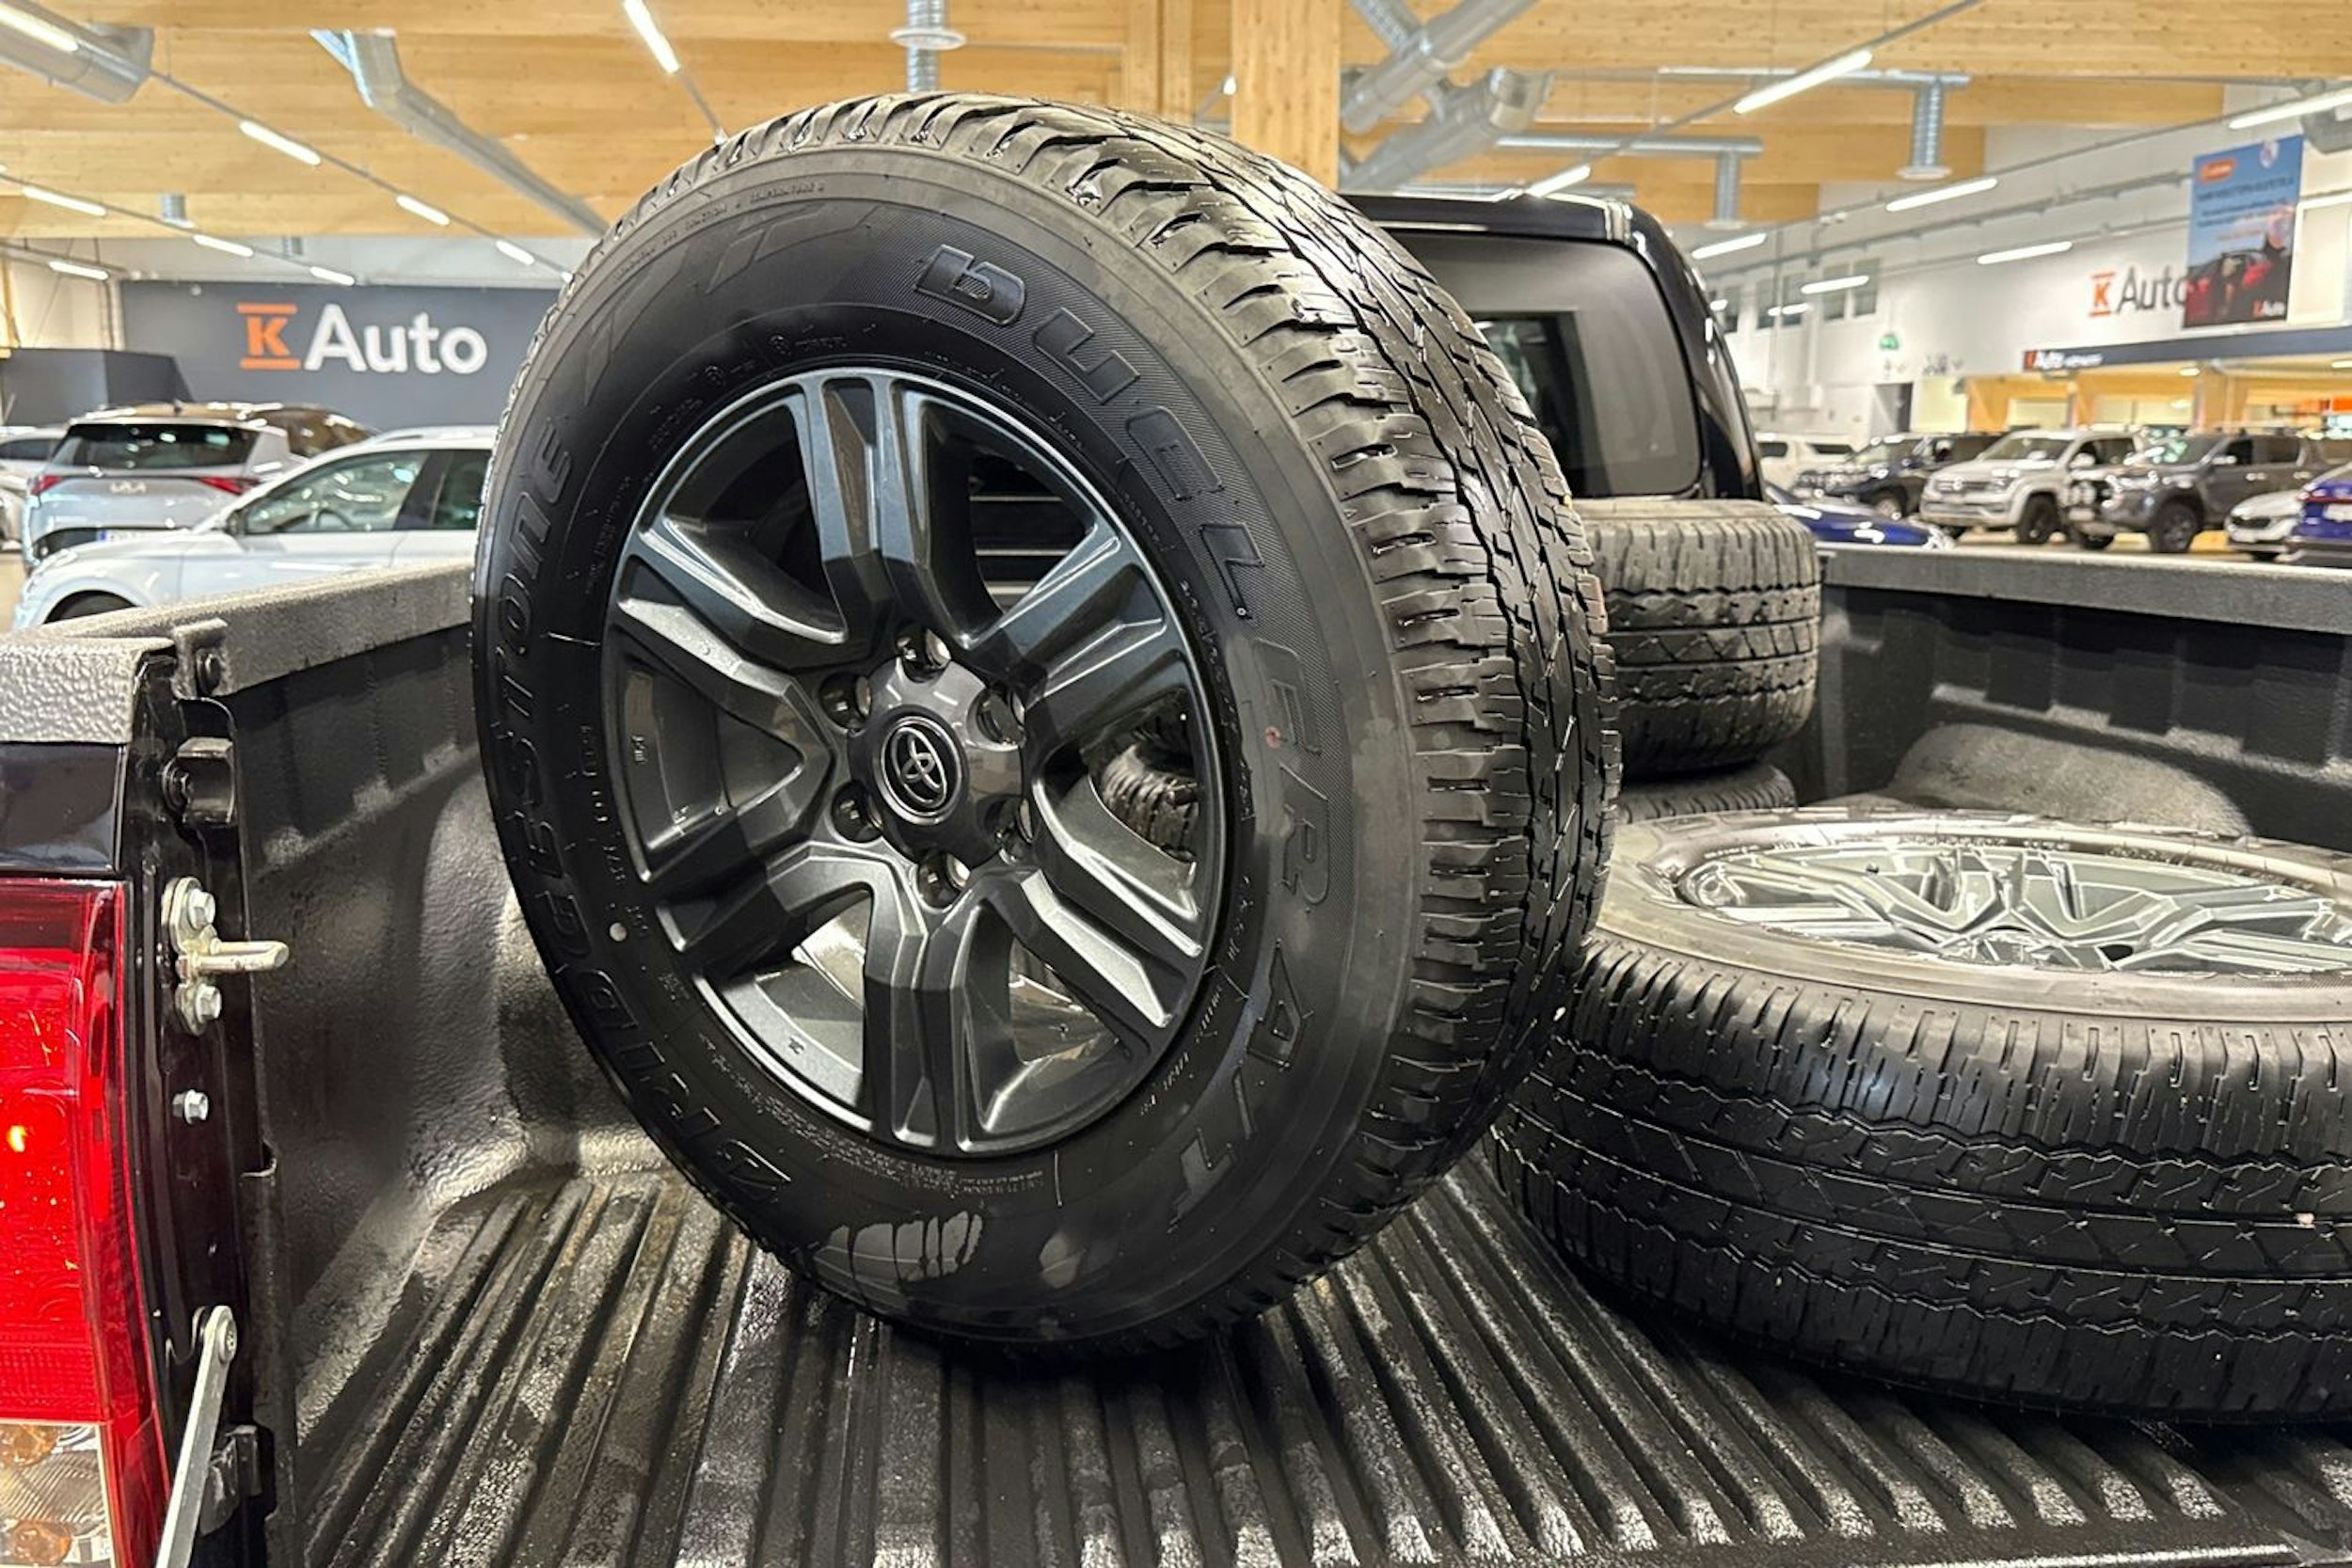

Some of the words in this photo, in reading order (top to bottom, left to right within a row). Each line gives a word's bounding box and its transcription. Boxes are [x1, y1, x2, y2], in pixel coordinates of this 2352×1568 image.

[304, 302, 488, 374] Auto
[914, 243, 1330, 907] DUELER
[490, 419, 792, 1200] BRIDGESTONE
